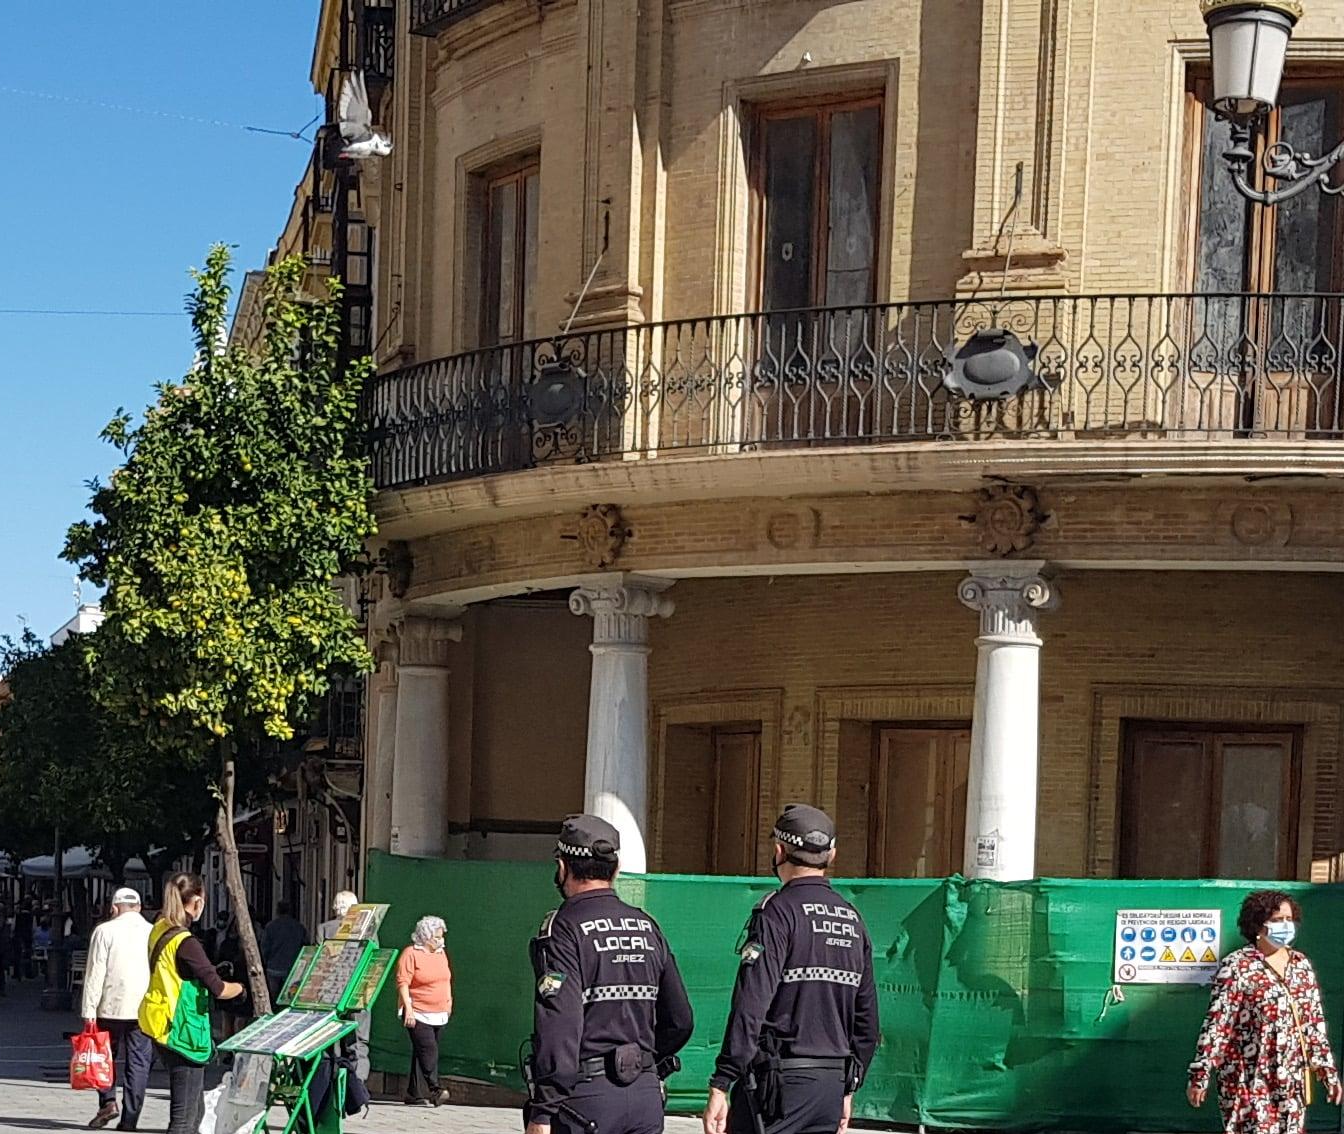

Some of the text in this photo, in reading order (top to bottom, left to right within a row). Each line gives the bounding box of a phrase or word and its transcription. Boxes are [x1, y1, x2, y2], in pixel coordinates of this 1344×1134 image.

[802, 903, 859, 922] POLICIA
[579, 917, 653, 936] POLICIA
[812, 920, 860, 938] LOCAL
[593, 936, 655, 952] LOCAL
